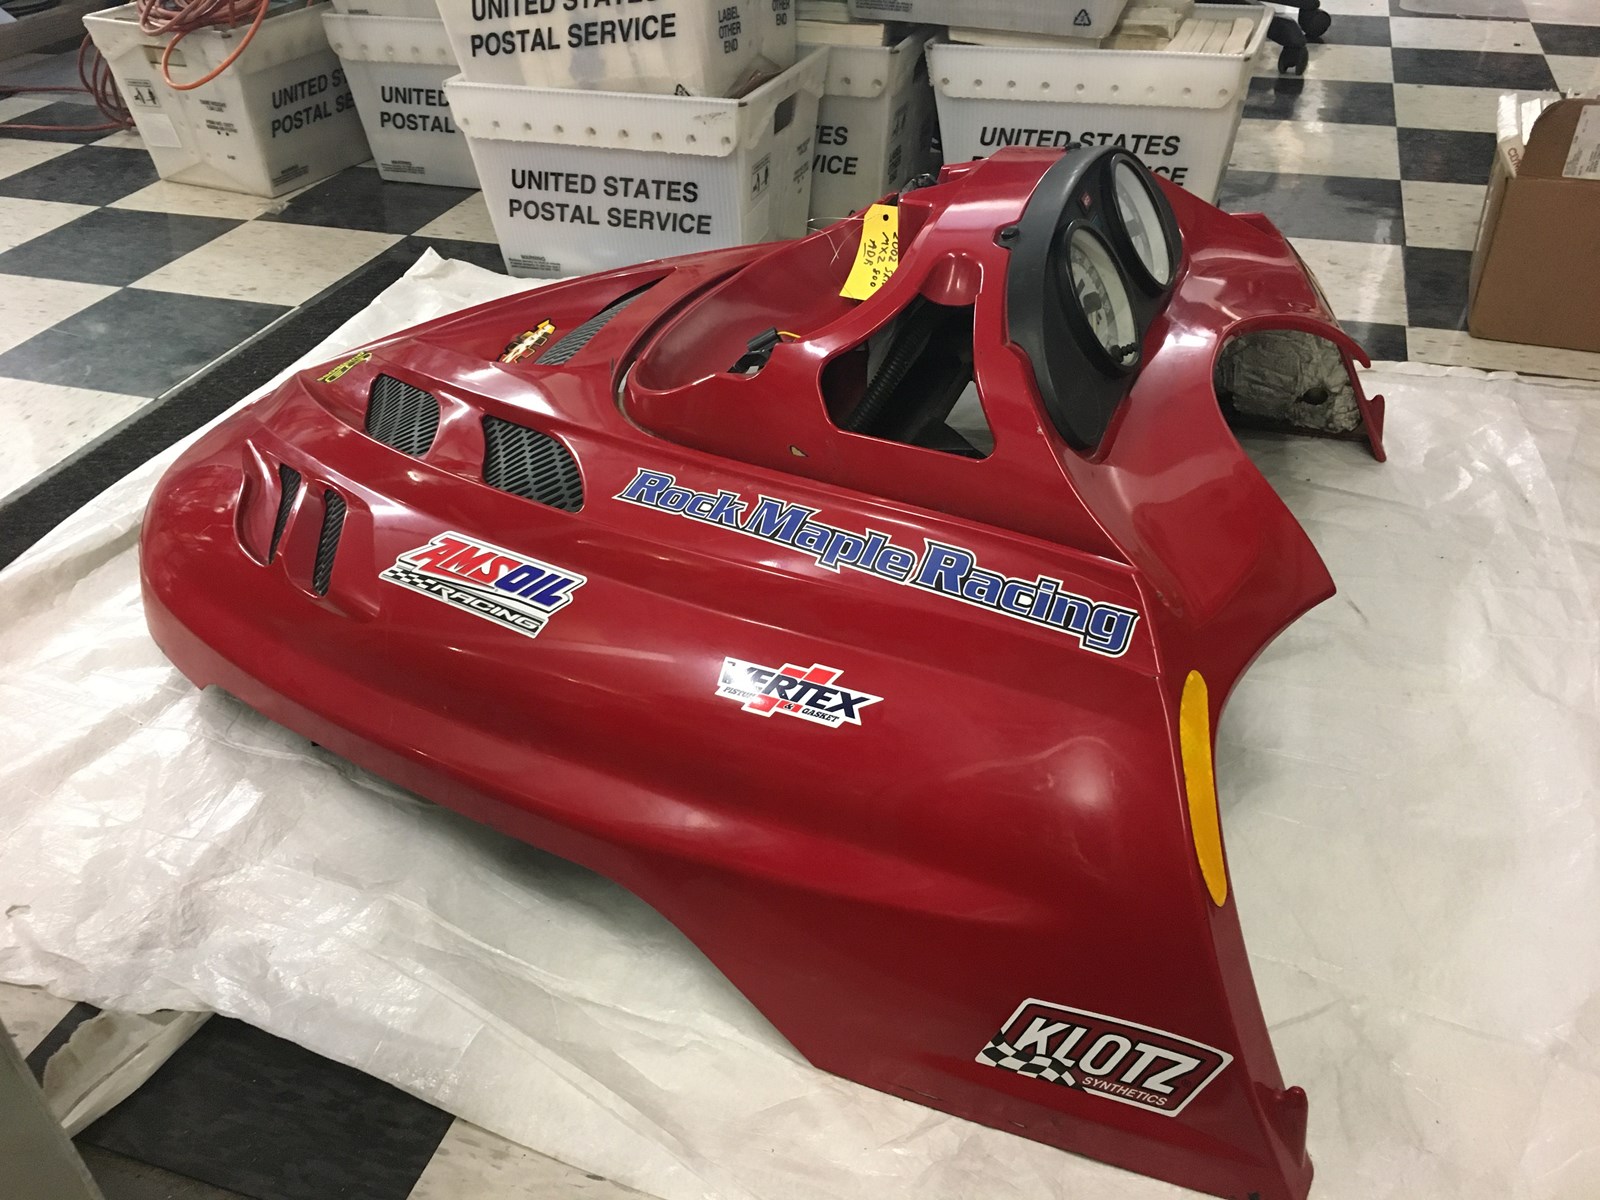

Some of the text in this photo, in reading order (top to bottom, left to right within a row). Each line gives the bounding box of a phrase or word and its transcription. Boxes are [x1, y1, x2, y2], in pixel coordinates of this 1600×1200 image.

[718, 6, 740, 23] LABEL
[719, 21, 741, 39] OTHER
[470, 13, 676, 57] POSTAL SERVICE
[724, 38, 738, 54] END
[271, 74, 328, 110] UNITED
[381, 85, 449, 107] UNITED
[271, 101, 332, 138] POSTAL
[380, 111, 455, 134] POSTAL
[816, 125, 849, 146] ES
[980, 126, 1181, 156] UNITED STATES
[511, 168, 698, 203] UNITED STATES
[509, 198, 712, 235] POSTAL SERVICE
[410, 537, 575, 607] AMSOIL
[616, 470, 1138, 655] Rock Maple Racing
[430, 580, 541, 631] RACING
[722, 661, 871, 719] ERTEX
[784, 702, 794, 711] &
[801, 707, 840, 723] GASKET
[1012, 1016, 1202, 1095] KLOTZ
[1081, 1075, 1168, 1107] SYNTHETICS
